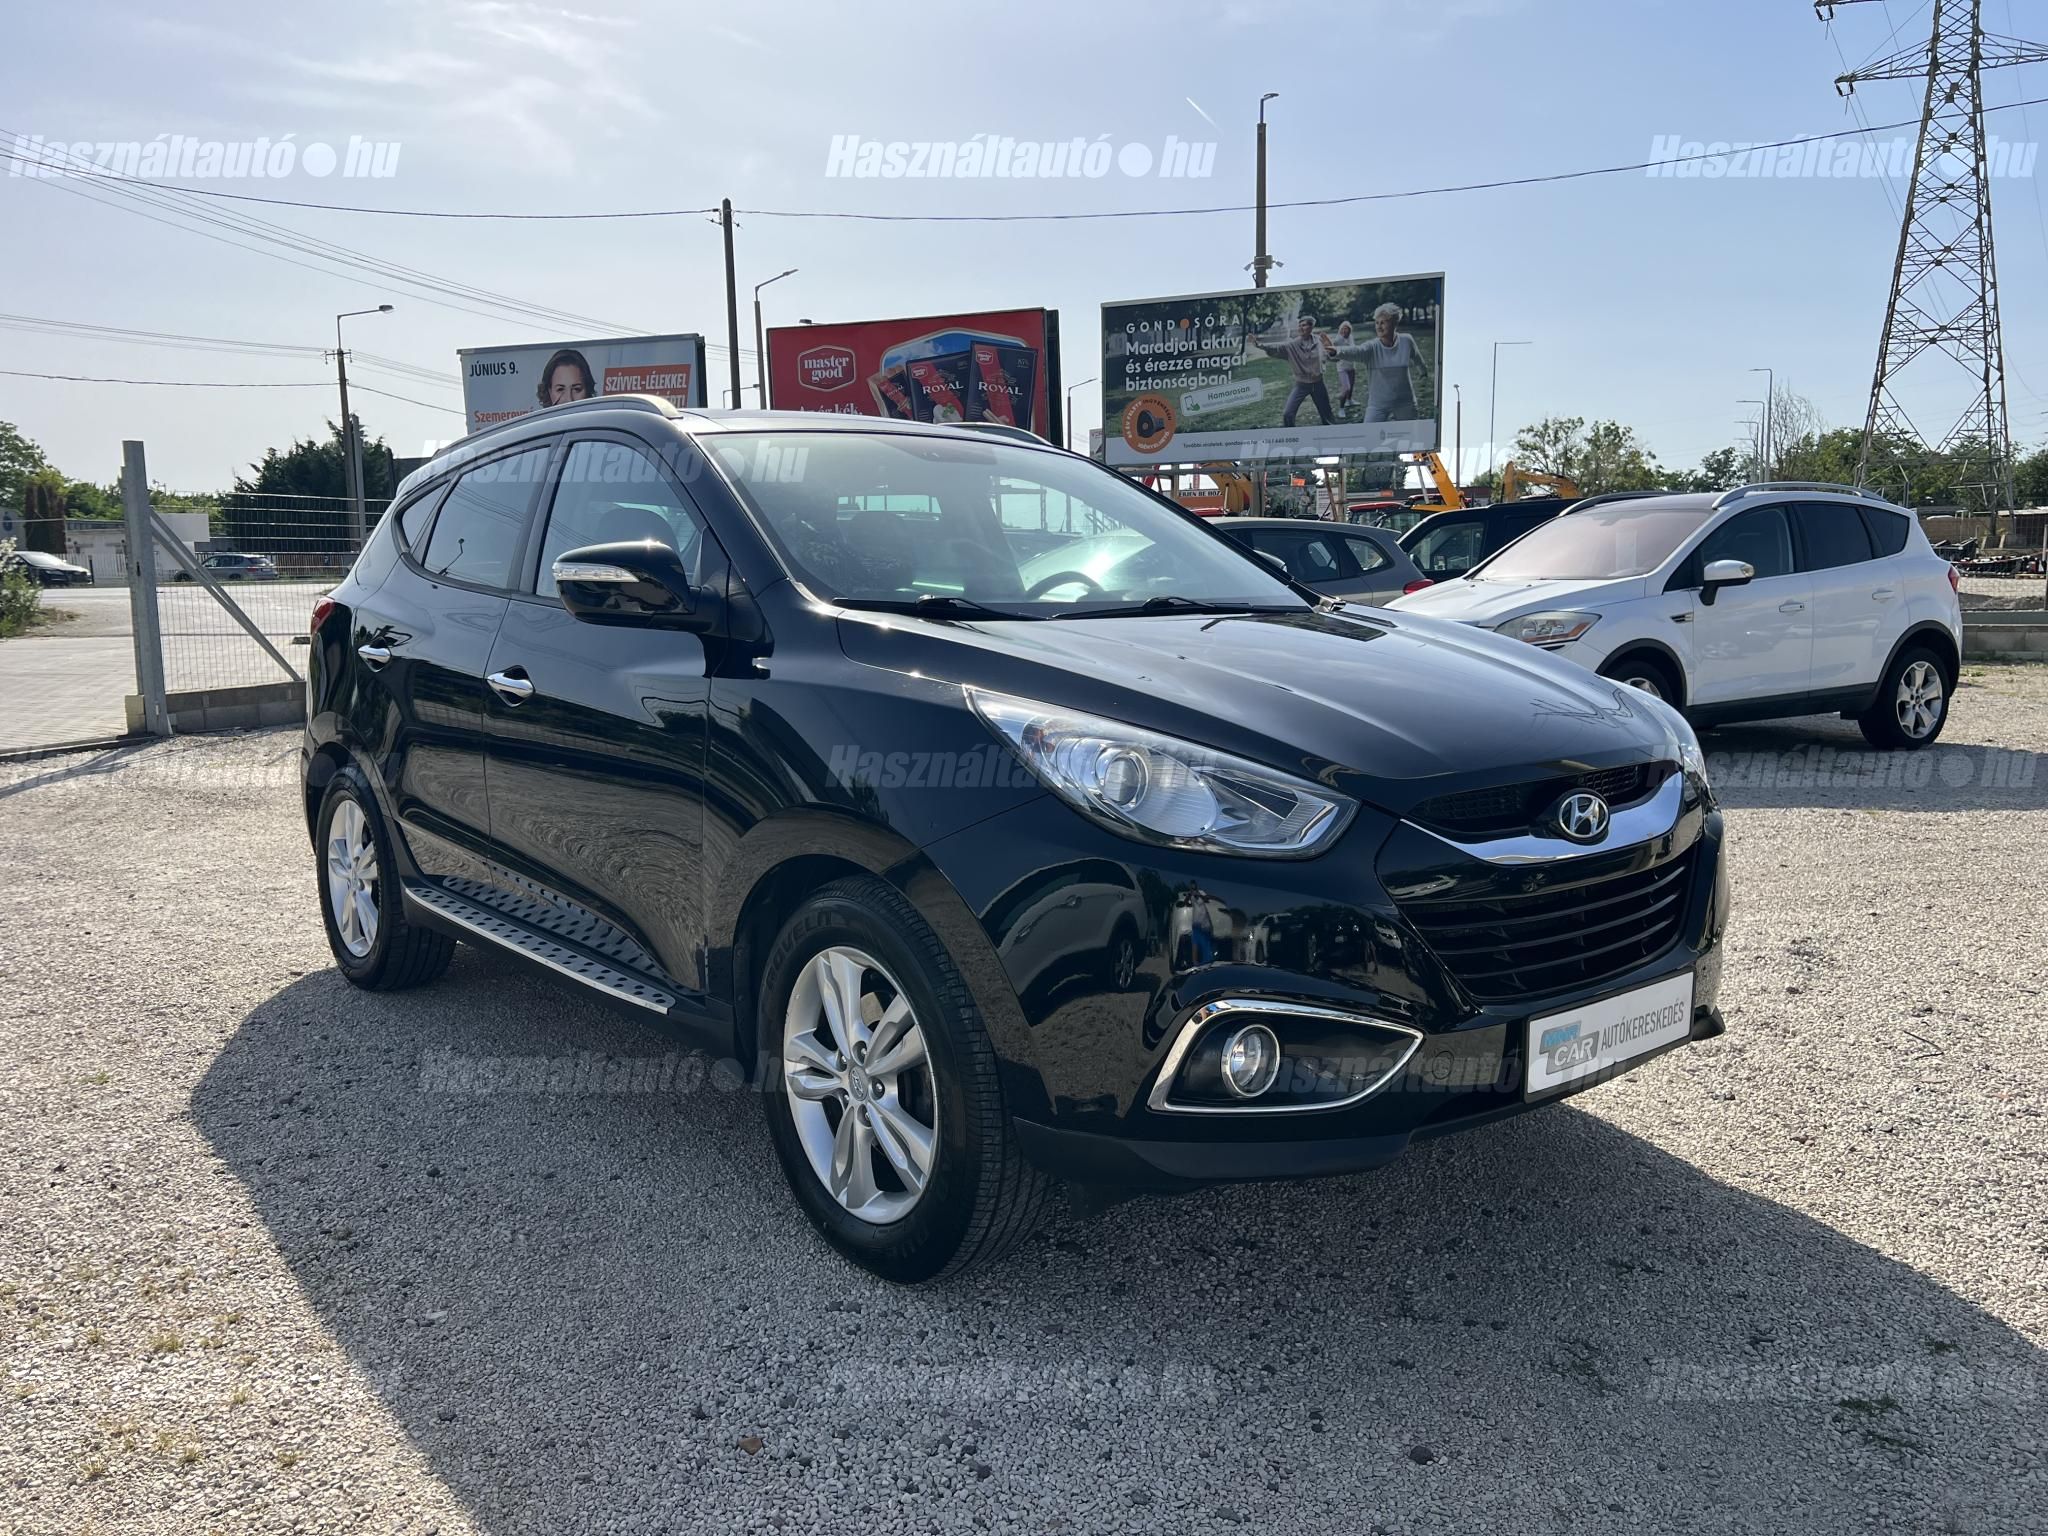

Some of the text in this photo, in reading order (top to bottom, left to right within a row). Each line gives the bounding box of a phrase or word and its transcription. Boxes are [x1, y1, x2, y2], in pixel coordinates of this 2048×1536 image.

[1126, 331, 1243, 356] Maradjon aktív,
[469, 360, 519, 377] JÚNIUS 9.
[804, 354, 849, 369] master
[1125, 352, 1248, 374] és érezze magát
[605, 371, 687, 392] SZÍVVEL-LÉLEKKEL
[811, 367, 843, 382] good
[1125, 372, 1233, 392] biztonságban!
[922, 380, 964, 395] ROYAL
[978, 381, 1024, 396] ROYAL
[1207, 385, 1250, 401] Hamarosan
[474, 407, 534, 423] Szemere
[1601, 998, 1685, 1050] AUTÓKERESKEDÉS
[1554, 1037, 1594, 1066] CAR
